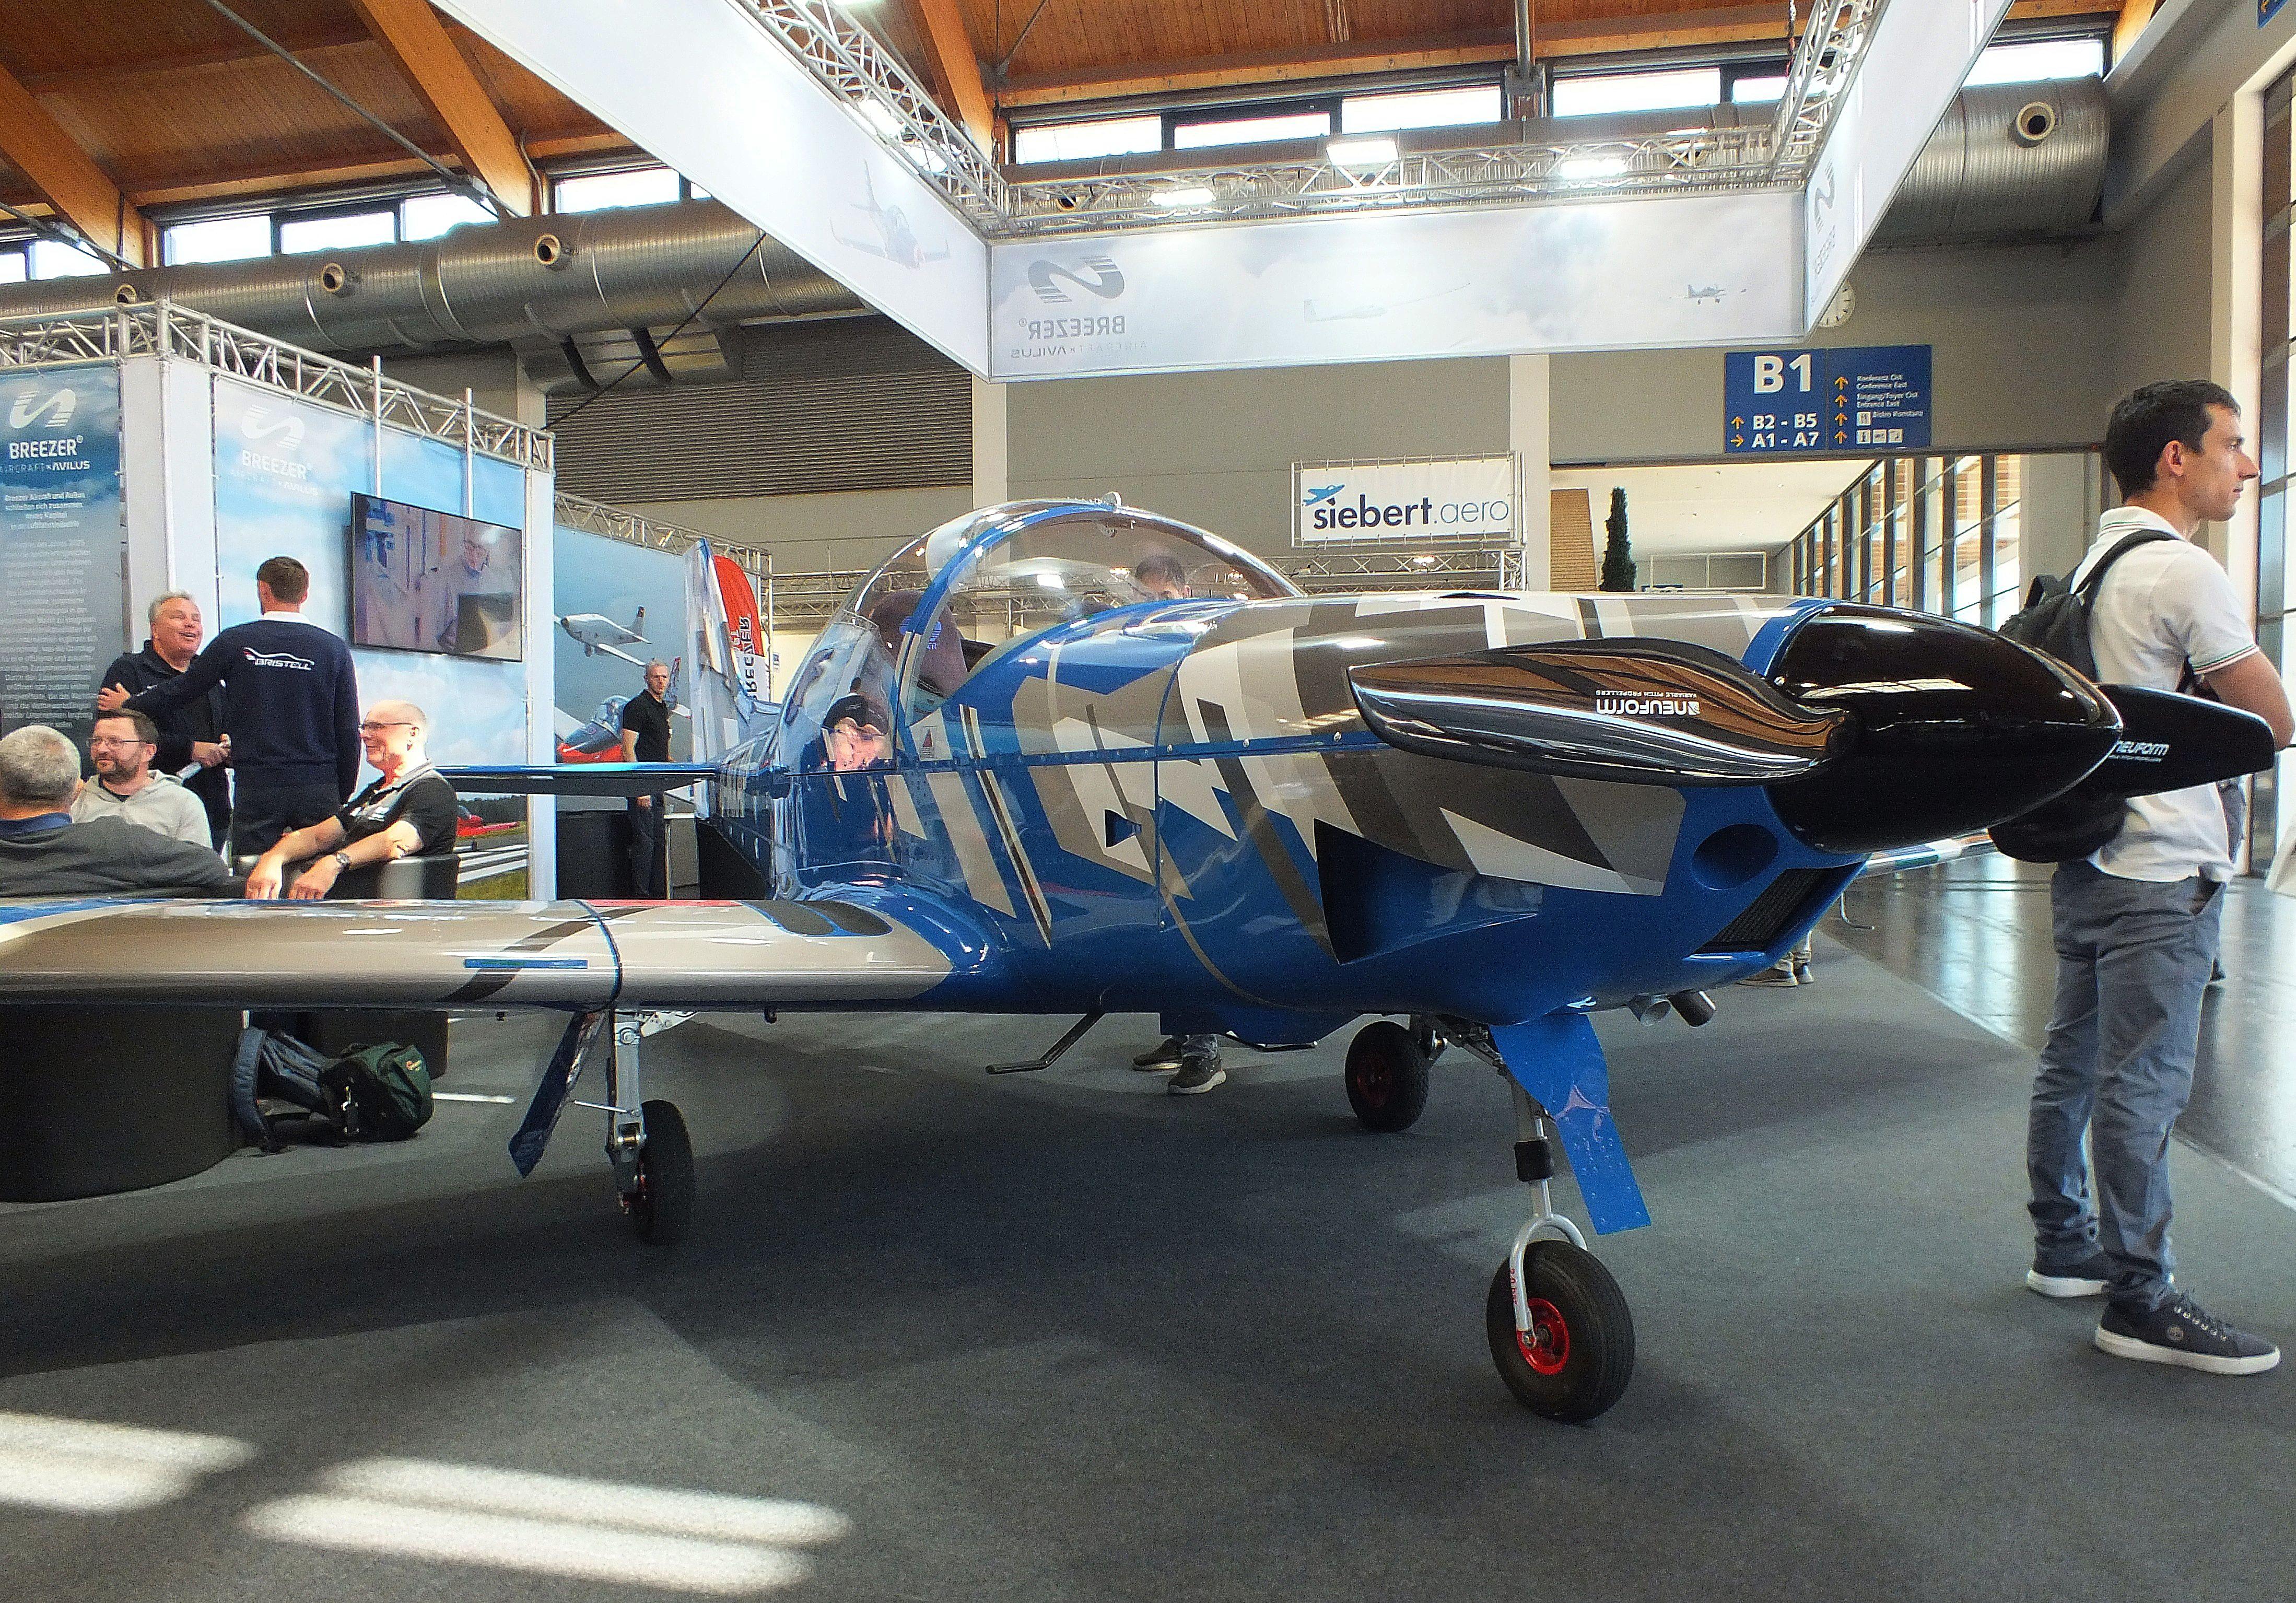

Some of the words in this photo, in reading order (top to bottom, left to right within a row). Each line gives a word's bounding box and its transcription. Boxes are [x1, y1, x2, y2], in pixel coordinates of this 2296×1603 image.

[1754, 354, 1811, 394] B1
[1753, 414, 1776, 430] B2
[1794, 413, 1818, 429] B5
[1752, 433, 1775, 448] A1
[1793, 432, 1819, 448] A7
[52, 460, 90, 471] AVILUS
[1314, 494, 1509, 530] siebert.aero
[255, 658, 312, 671] BRISTELL
